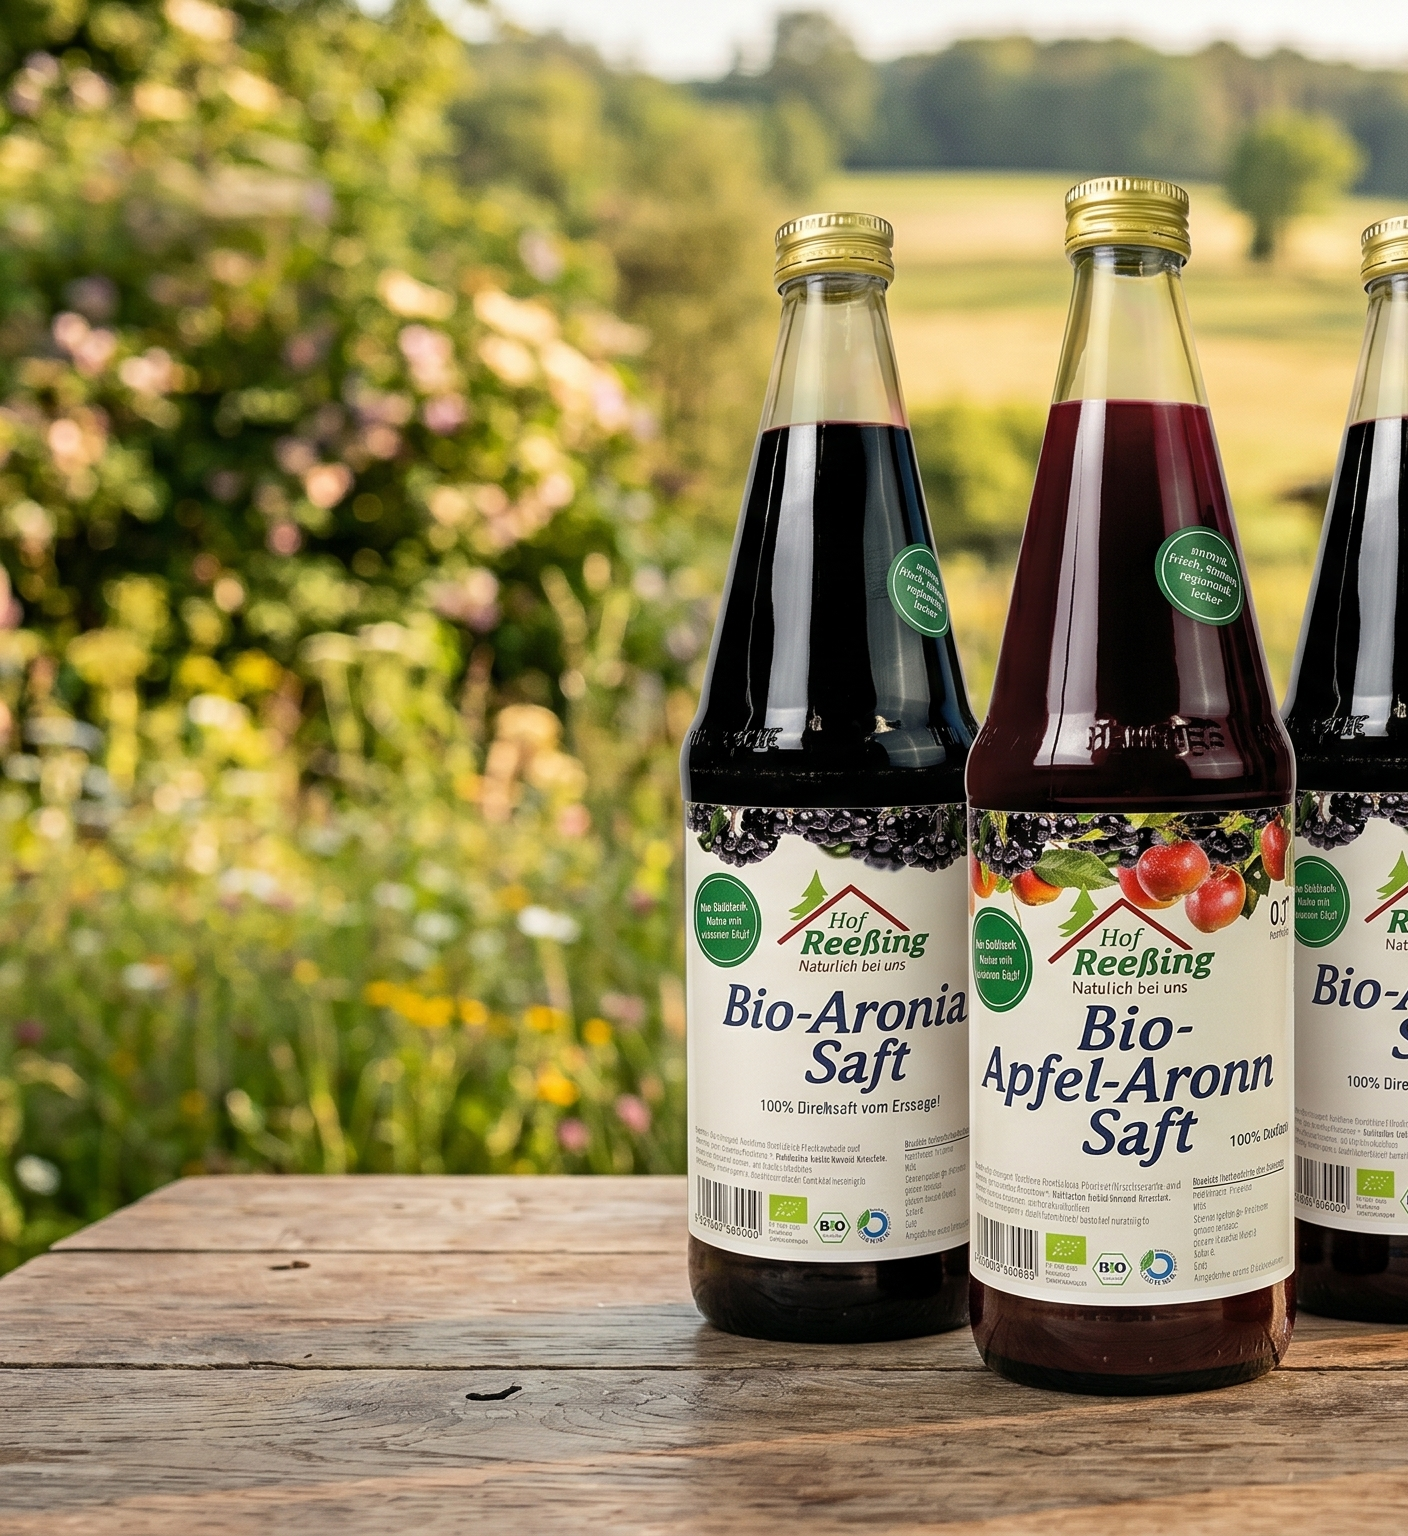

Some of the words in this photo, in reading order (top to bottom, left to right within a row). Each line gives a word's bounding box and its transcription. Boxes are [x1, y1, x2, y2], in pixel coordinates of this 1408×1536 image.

[1190, 587, 1223, 605] lecker
[828, 912, 870, 933] Hof
[800, 929, 930, 958] Reeßing
[1100, 928, 1145, 950] Hof
[862, 960, 881, 972] bei
[884, 960, 907, 972] uns
[1072, 948, 1216, 979] Reeßing
[1138, 981, 1159, 994] bei
[1164, 983, 1188, 994] uns
[1077, 1004, 1194, 1052] Bio-
[804, 1037, 912, 1095] Saft
[981, 1045, 1274, 1111] Apfel-Aronn
[1347, 1075, 1380, 1089] 100%
[760, 1099, 794, 1113] 100%
[862, 1102, 888, 1114] vom
[1081, 1105, 1199, 1168] Saft
[1230, 1130, 1261, 1147] 100%
